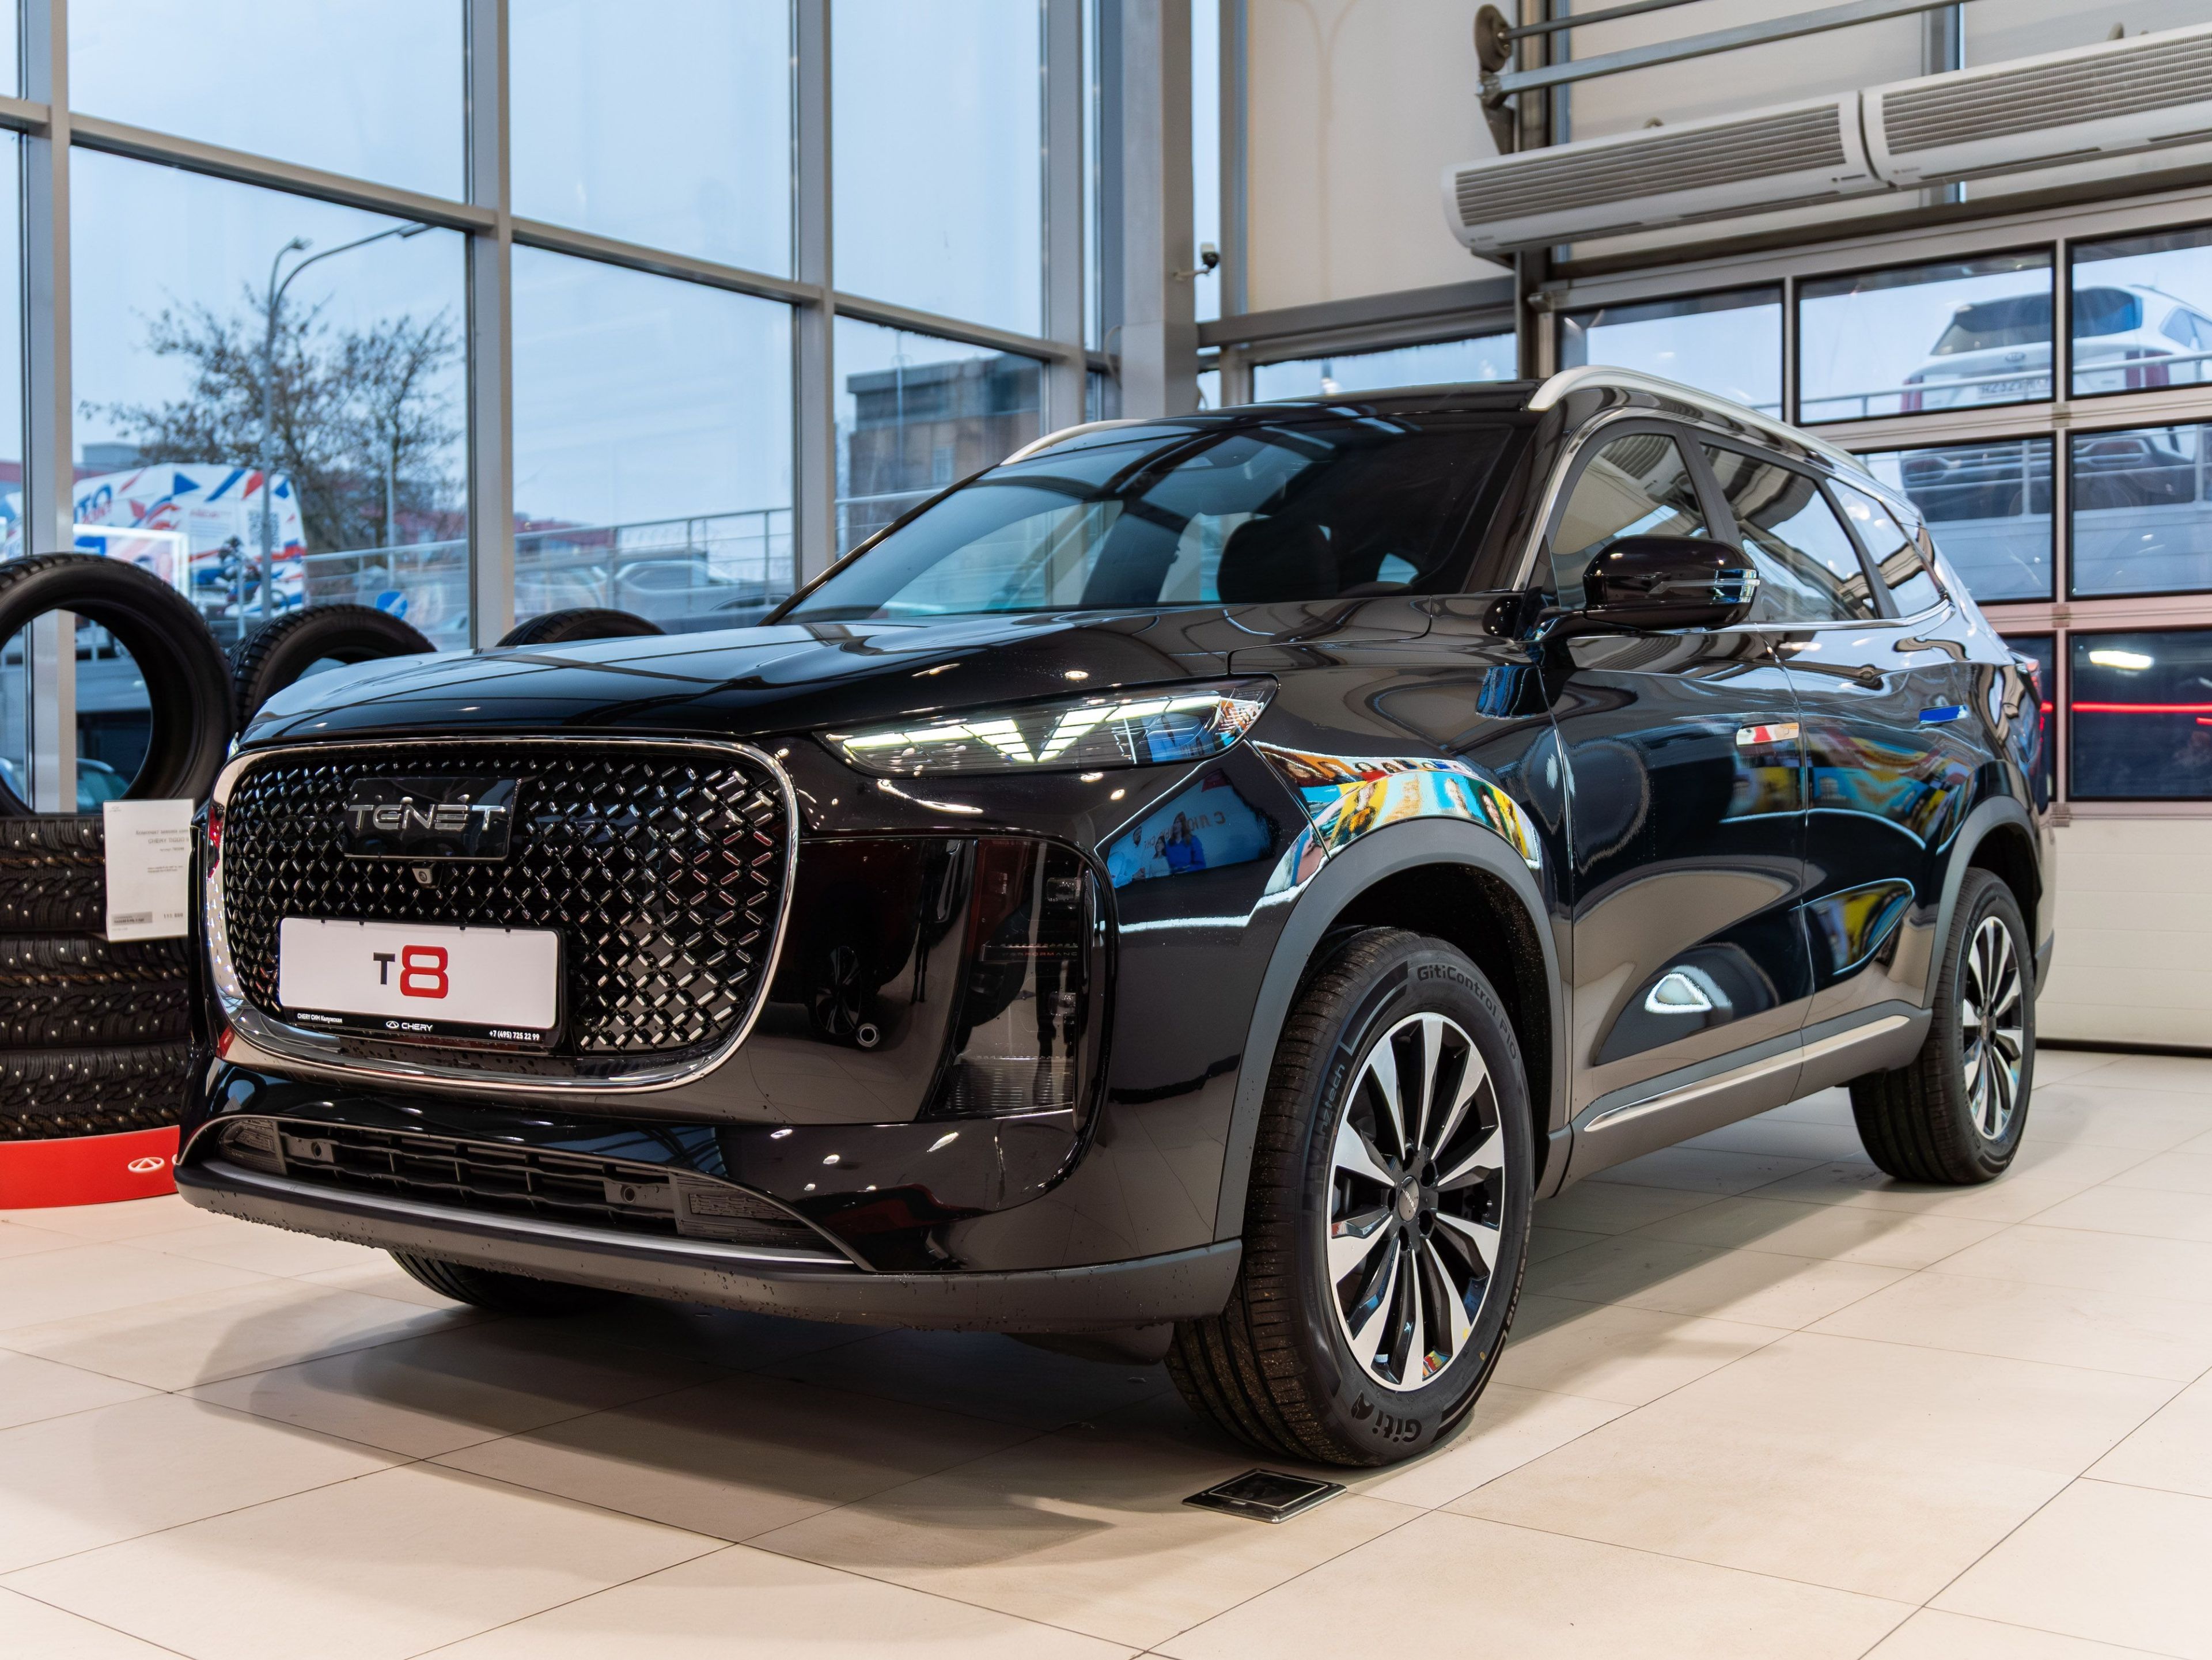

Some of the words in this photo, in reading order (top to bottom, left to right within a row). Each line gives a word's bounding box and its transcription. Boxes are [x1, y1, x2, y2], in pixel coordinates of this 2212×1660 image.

[349, 805, 505, 831] TENET
[373, 945, 449, 999] T8
[402, 1022, 433, 1032] CHERY
[1417, 965, 1497, 1017] GitiControl
[1499, 1018, 1517, 1060] P10
[497, 1030, 512, 1039] (495)
[513, 1032, 523, 1040] 725
[532, 1033, 540, 1041] 99
[1372, 1410, 1423, 1443] Giti
